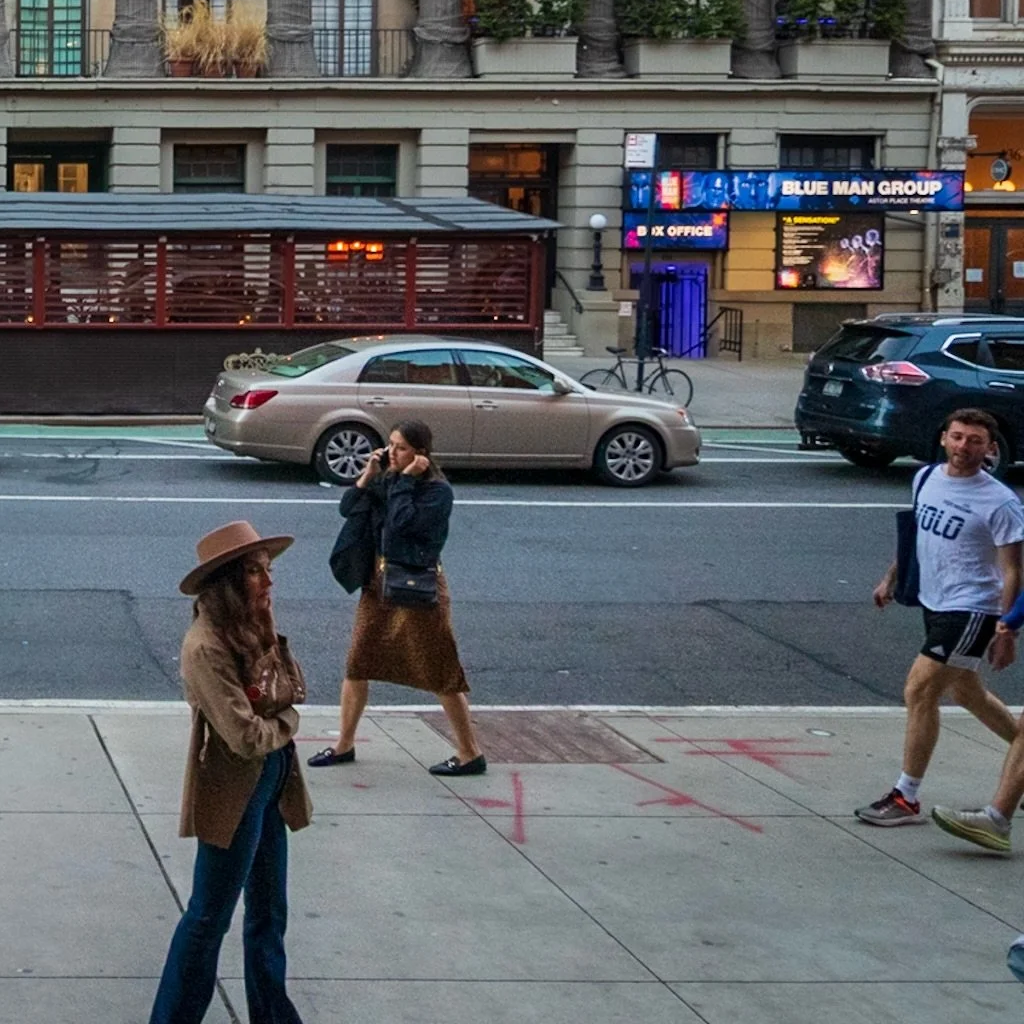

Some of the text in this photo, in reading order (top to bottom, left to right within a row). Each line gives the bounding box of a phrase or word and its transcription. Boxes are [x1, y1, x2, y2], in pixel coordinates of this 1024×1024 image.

[781, 180, 943, 196] BLUE MAN GROUP
[667, 225, 713, 237] OFFICE
